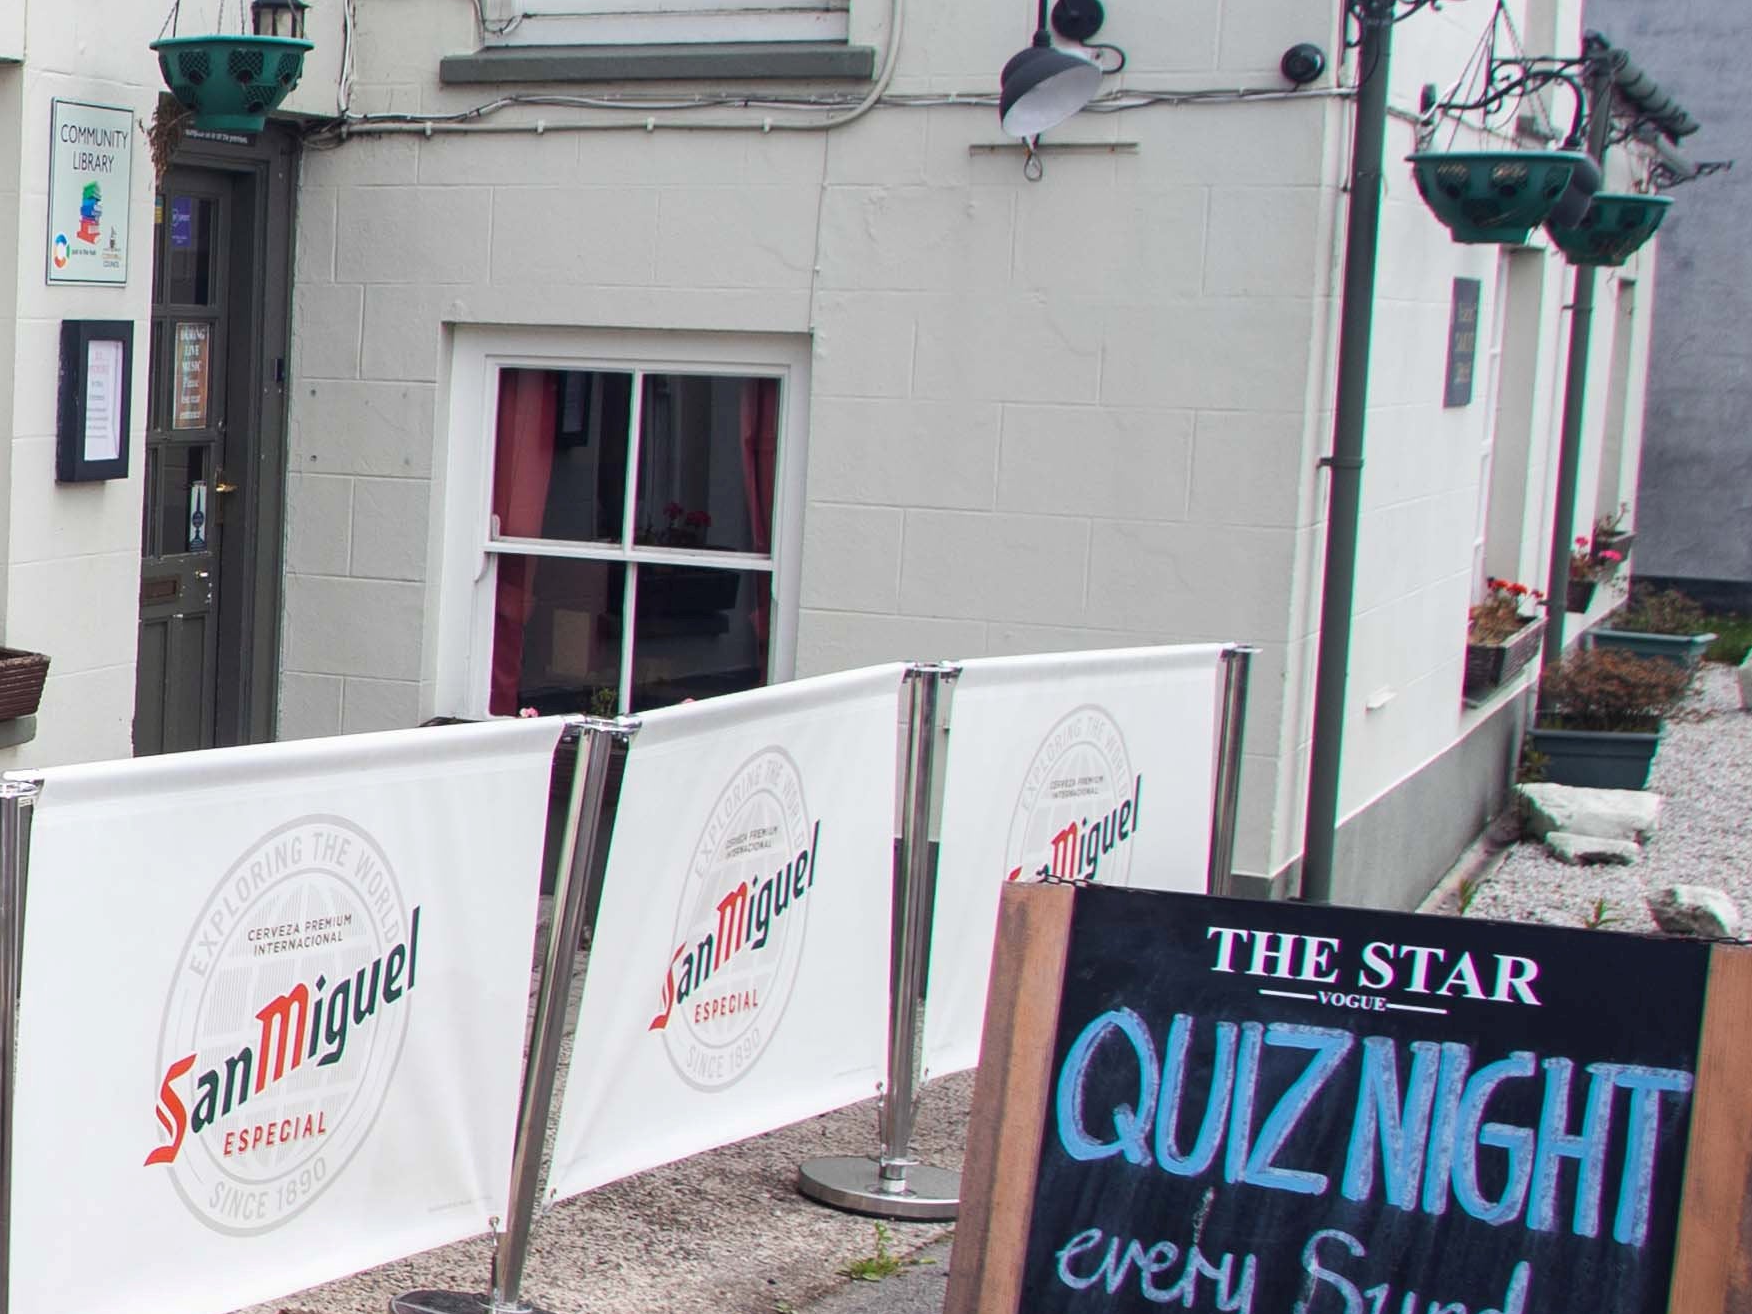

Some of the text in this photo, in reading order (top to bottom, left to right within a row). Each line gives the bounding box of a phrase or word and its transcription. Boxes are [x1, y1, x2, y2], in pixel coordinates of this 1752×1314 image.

[61, 124, 128, 149] COMMUNITY
[73, 152, 114, 173] LIBRARY
[1087, 716, 1106, 742] THE
[189, 832, 400, 977] EXPLORING THE WORLD
[247, 913, 353, 941] CERVEZA PREMIUM
[254, 930, 344, 956] INTERNACIONAL
[1206, 926, 1543, 1006] THE STAR
[694, 989, 759, 1024] ESPECIAL
[1317, 990, 1387, 1012] VOGUE
[686, 1045, 724, 1079] SINCE
[224, 1111, 327, 1157] ESPECIAL
[1055, 1005, 1694, 1248] QUIZ NIGHT
[208, 1156, 328, 1221] SINCE 1890
